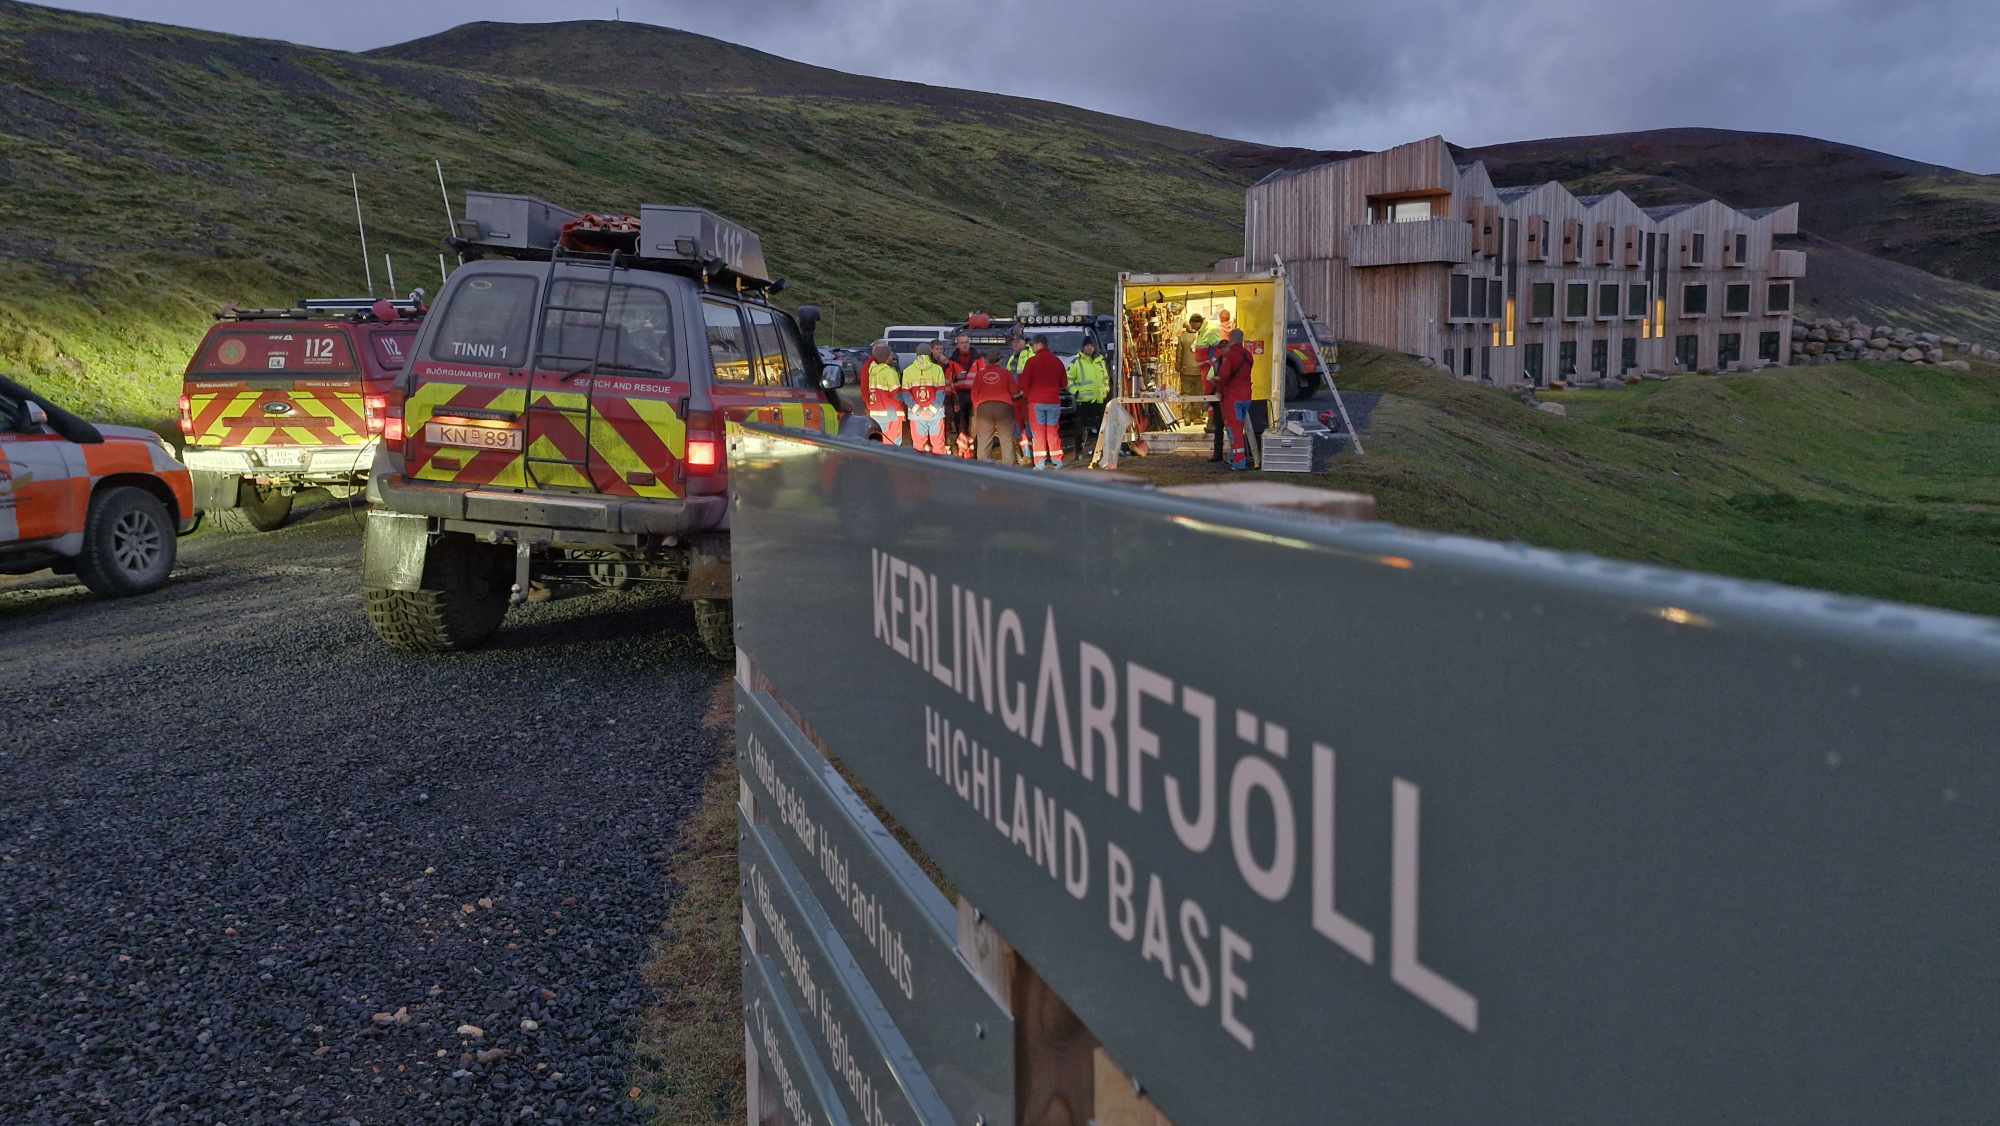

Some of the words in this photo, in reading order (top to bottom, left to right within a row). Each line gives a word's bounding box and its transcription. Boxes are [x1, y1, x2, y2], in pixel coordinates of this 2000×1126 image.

[723, 227, 743, 269] 112
[305, 338, 334, 357] 112
[380, 337, 401, 355] 112
[453, 341, 495, 358] TINNI
[499, 344, 508, 359] 1
[426, 367, 501, 380] BJÖRGUNARSVEIT
[613, 382, 632, 391] AND
[634, 383, 672, 393] RESCUE
[440, 426, 468, 443] KN
[484, 431, 517, 447] 891
[755, 737, 776, 800] Hótel
[776, 775, 786, 824] og
[820, 824, 849, 906] Hotel
[852, 882, 876, 947] and
[879, 904, 913, 1000] huts
[925, 705, 1089, 900] HIGHLAND
[1108, 842, 1255, 1051] BASE
[821, 989, 870, 1125] Highland
